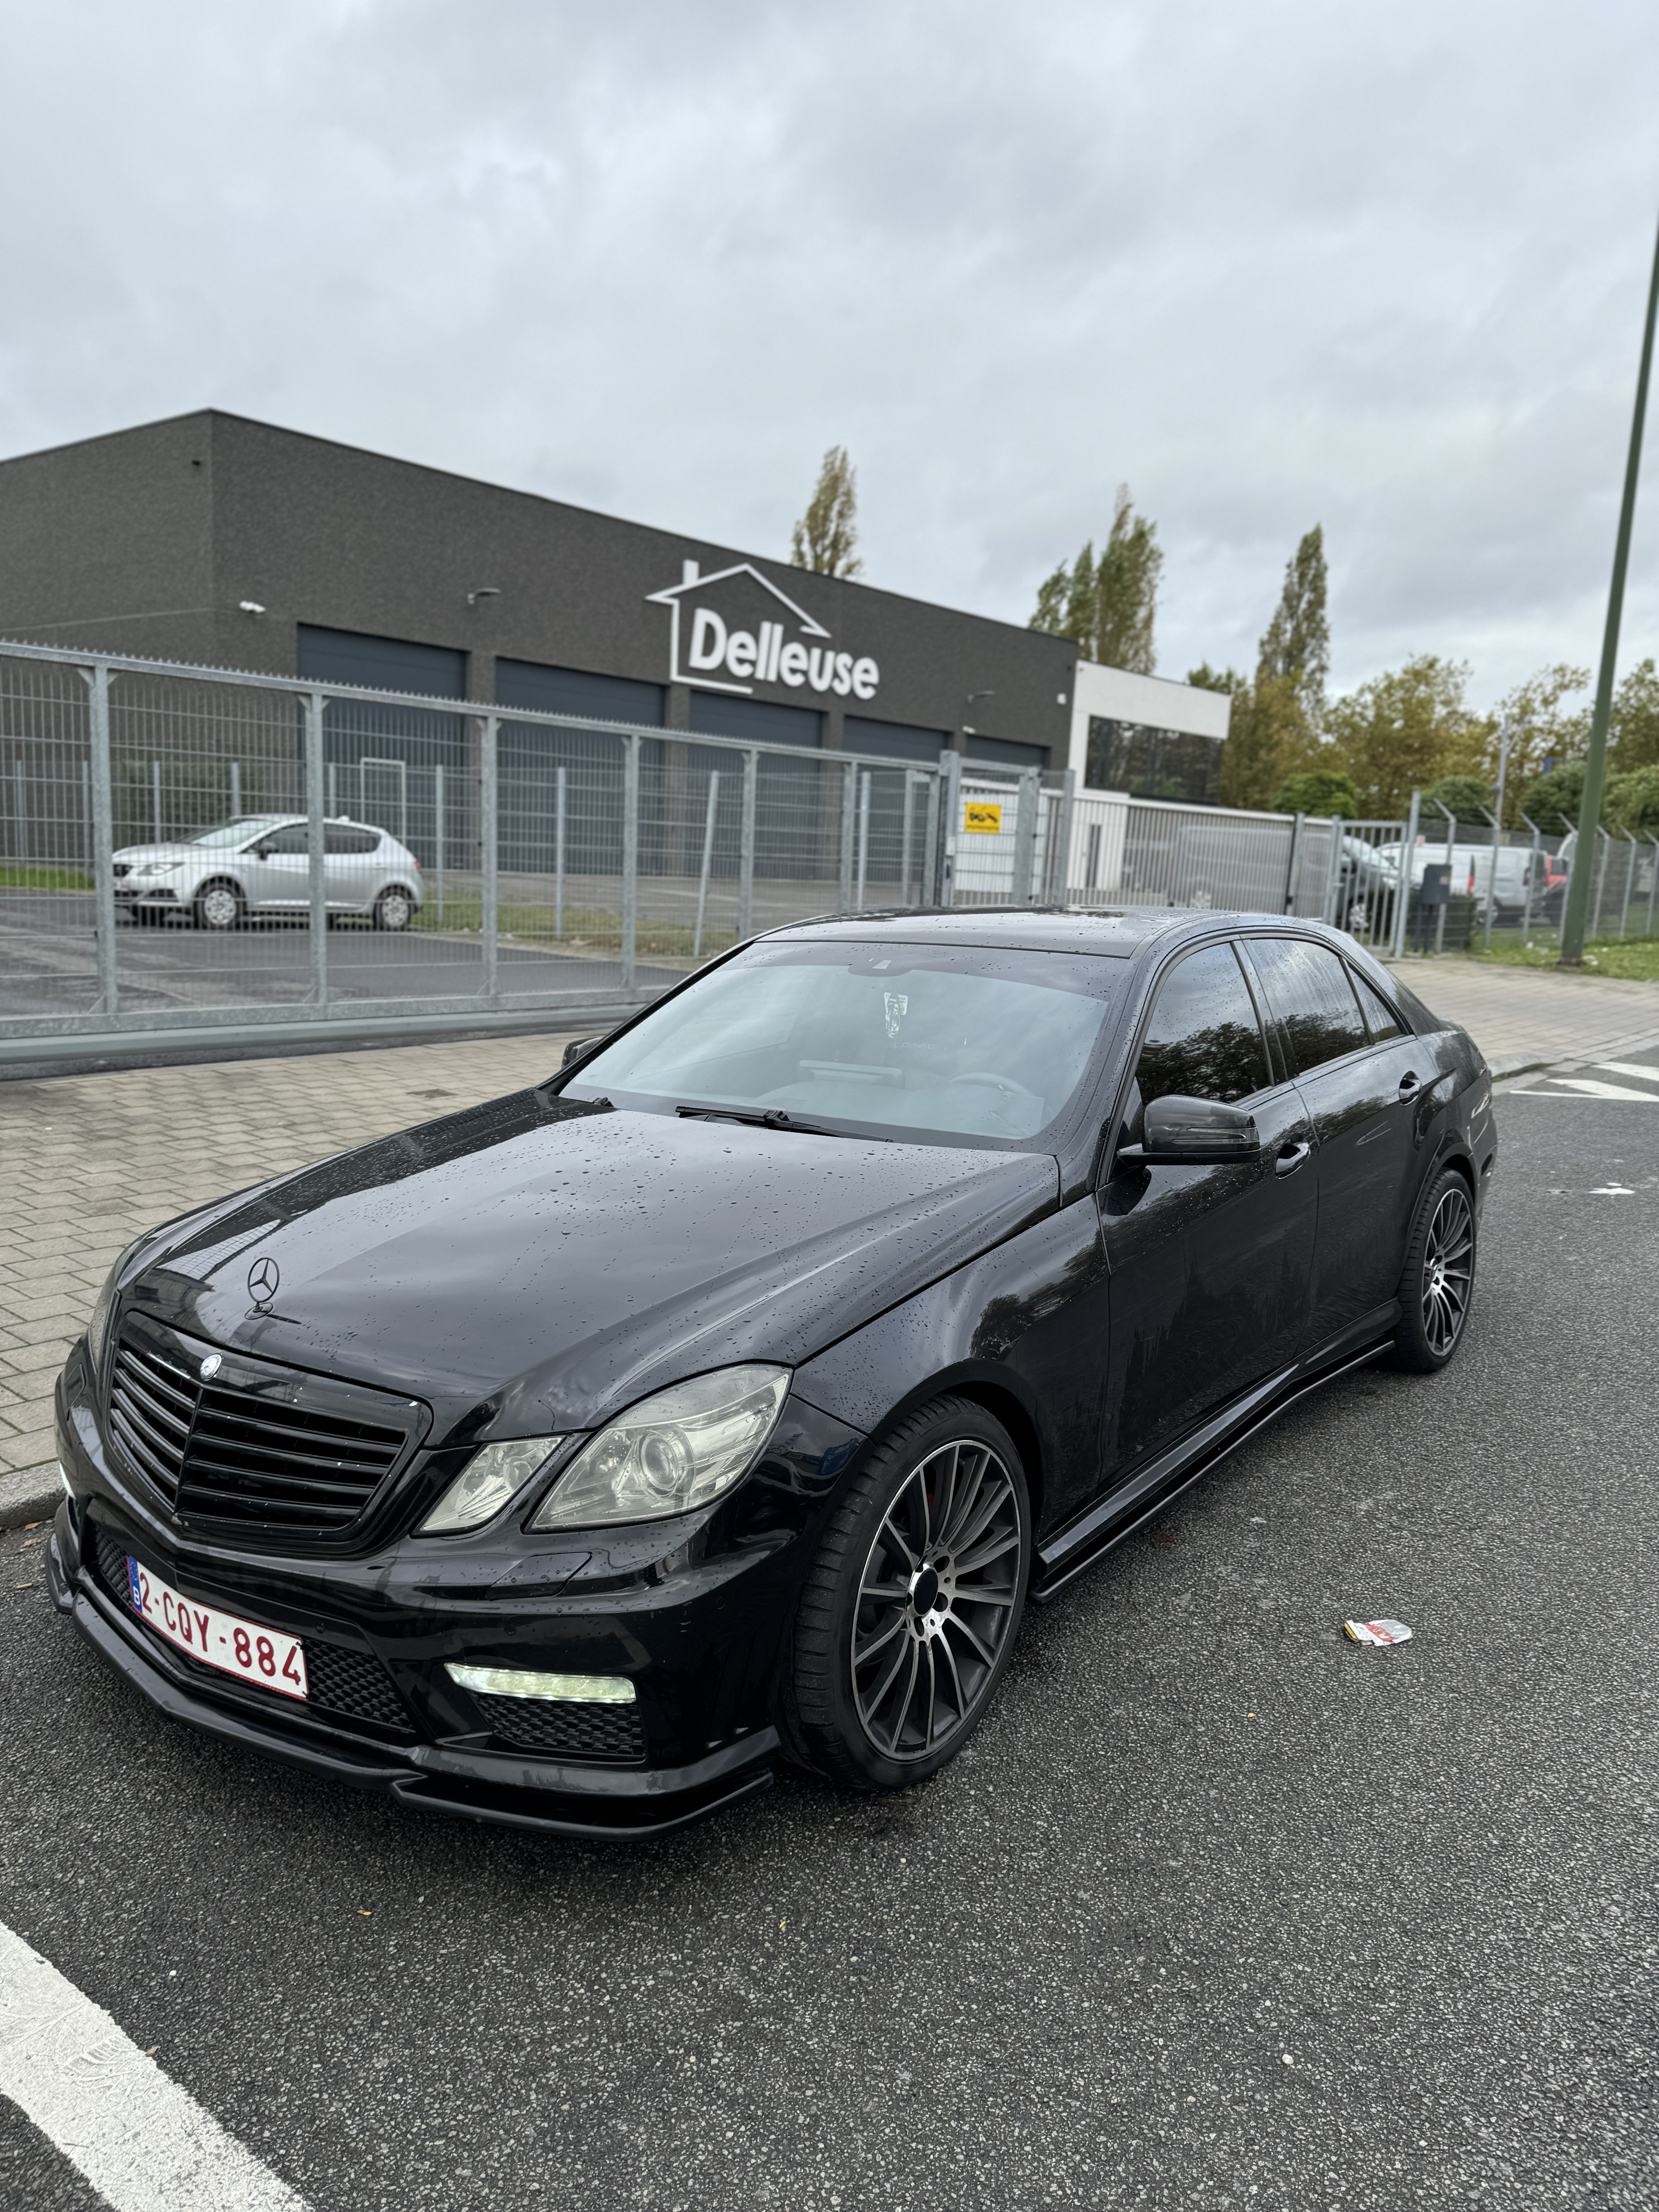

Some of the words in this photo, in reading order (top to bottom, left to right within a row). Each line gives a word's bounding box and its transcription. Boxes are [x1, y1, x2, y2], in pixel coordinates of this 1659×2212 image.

[689, 607, 879, 699] Delleuse
[133, 1586, 140, 1605] B
[140, 1572, 301, 1685] 2-CQY-884
